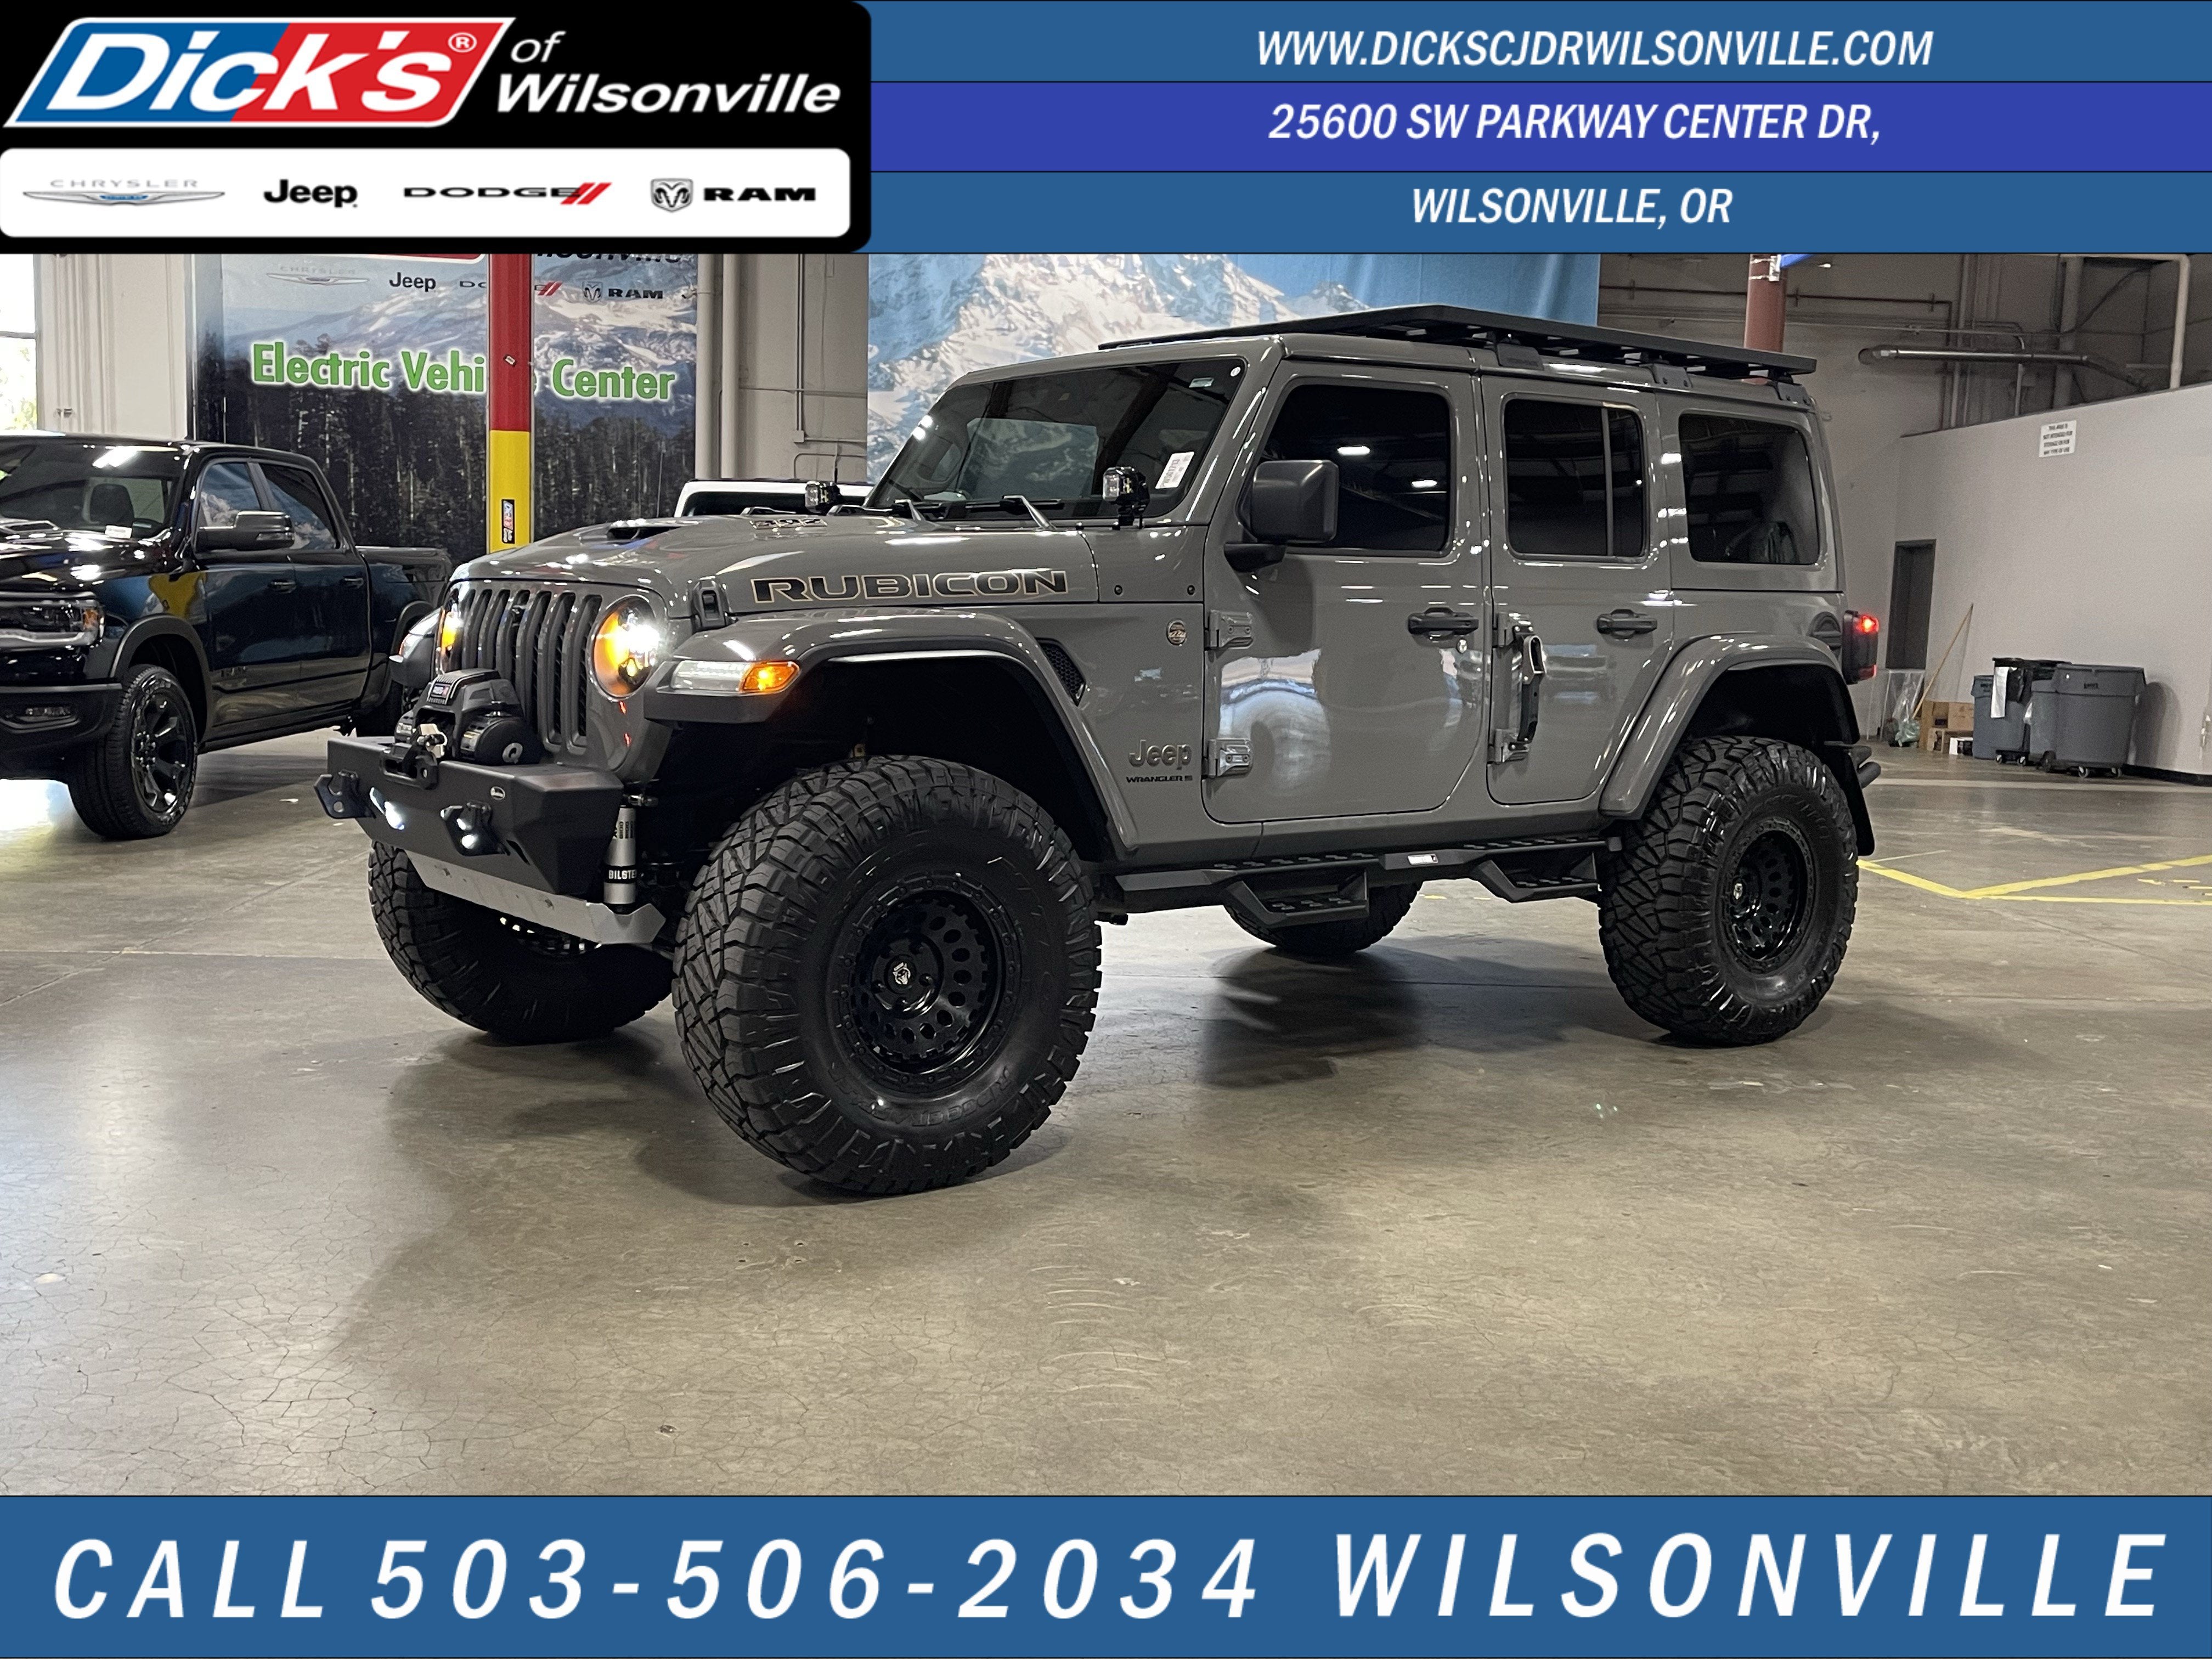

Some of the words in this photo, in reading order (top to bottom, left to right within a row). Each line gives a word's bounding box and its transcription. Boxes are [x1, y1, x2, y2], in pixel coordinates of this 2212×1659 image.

[389, 272, 436, 292] Jeep
[608, 288, 664, 299] RAM
[253, 342, 390, 387] Electric
[402, 350, 537, 393] Vehi
[552, 358, 676, 400] Center
[749, 570, 1069, 603] RUBICON
[1128, 740, 1192, 770] Jeep
[1126, 775, 1183, 783] WRANGLER
